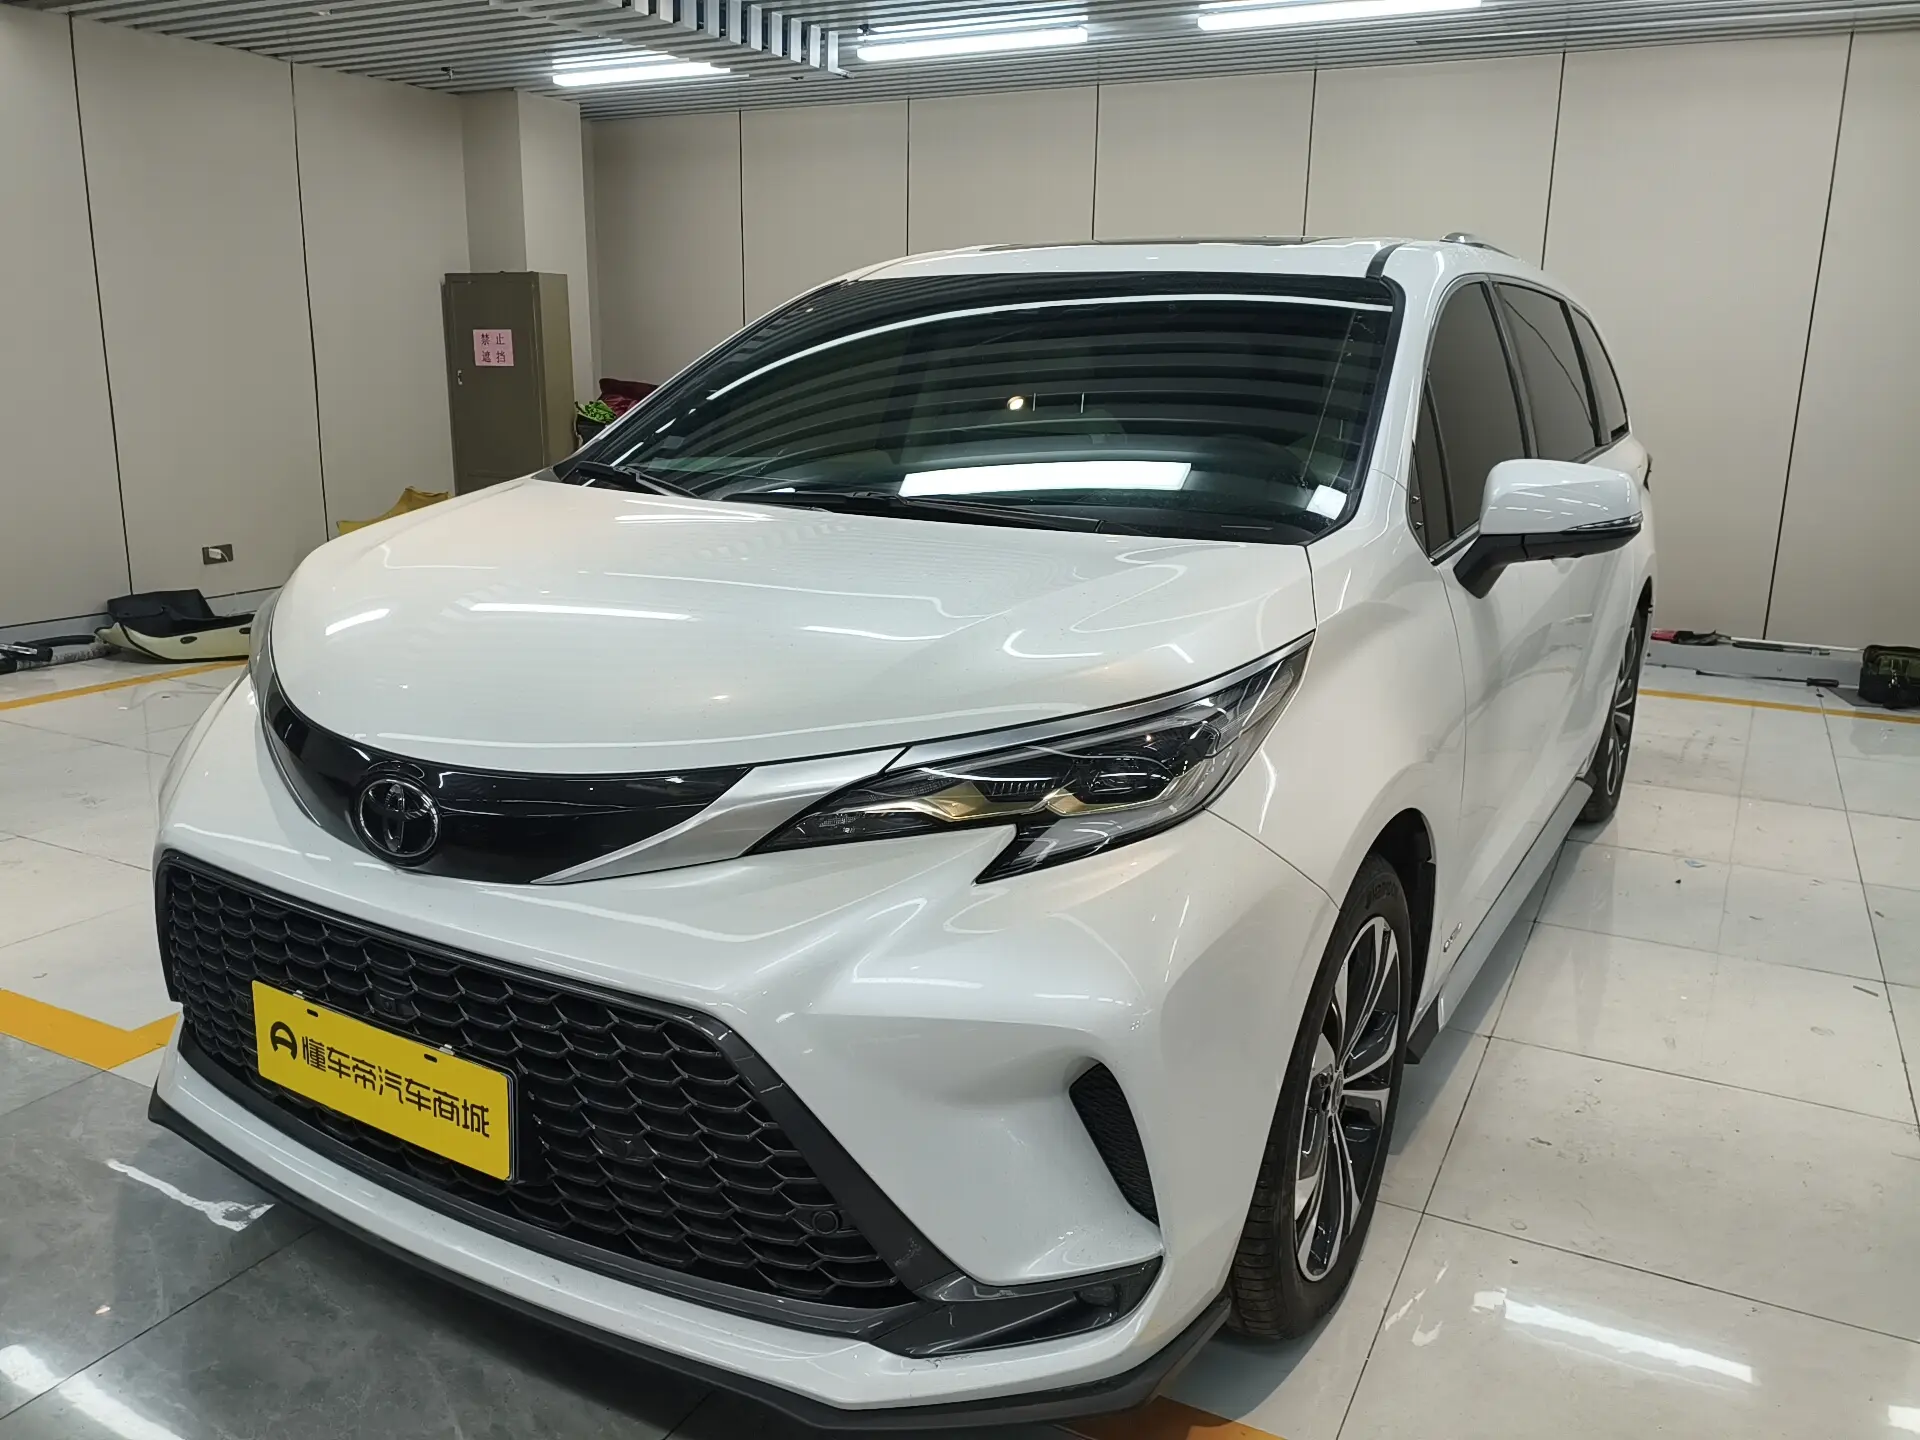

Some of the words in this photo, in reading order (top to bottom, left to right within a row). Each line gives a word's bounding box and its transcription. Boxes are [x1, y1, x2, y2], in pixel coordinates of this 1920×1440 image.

[481, 333, 506, 346] 禁止
[302, 1036, 490, 1138] 懂车帝汽车商城
